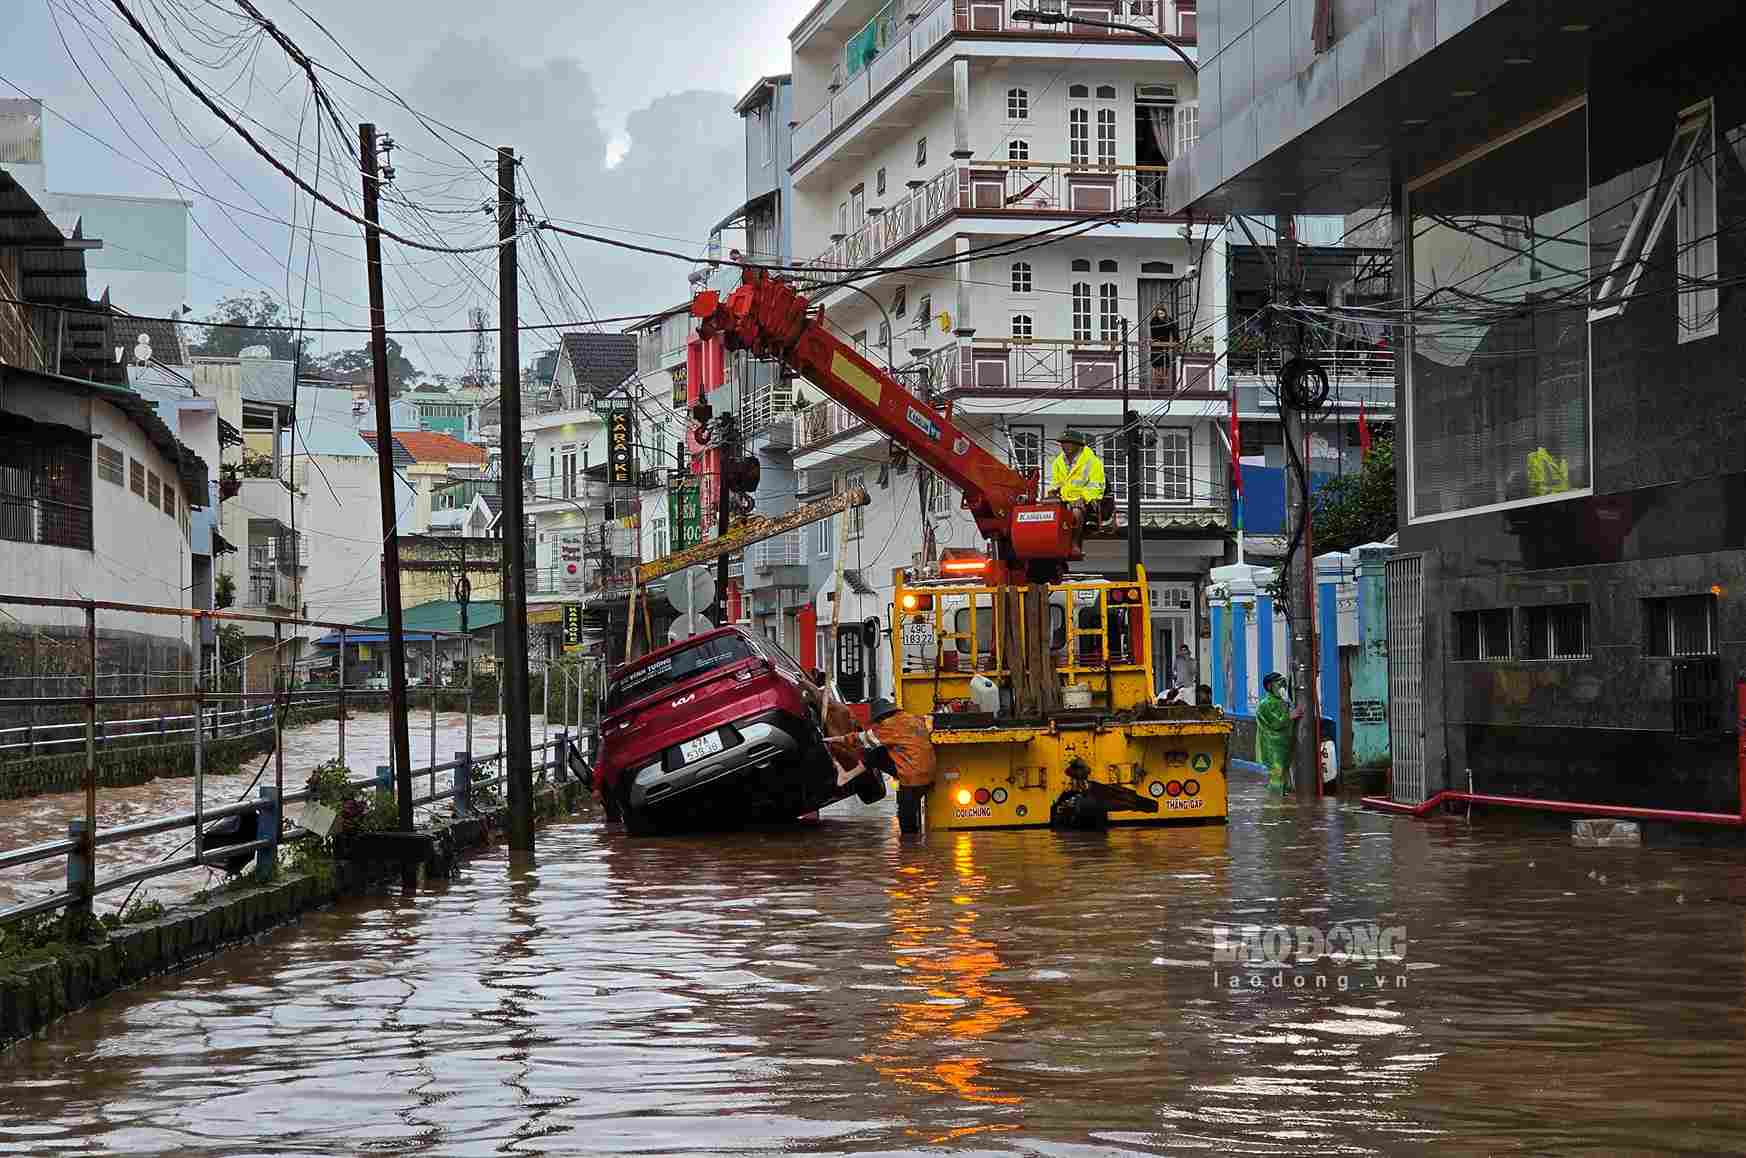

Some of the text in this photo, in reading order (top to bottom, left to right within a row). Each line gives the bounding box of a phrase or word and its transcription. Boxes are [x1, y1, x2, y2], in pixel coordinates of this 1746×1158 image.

[613, 414, 627, 481] KARAOKE
[568, 607, 579, 642] KARAOKE
[671, 693, 696, 708] KIA
